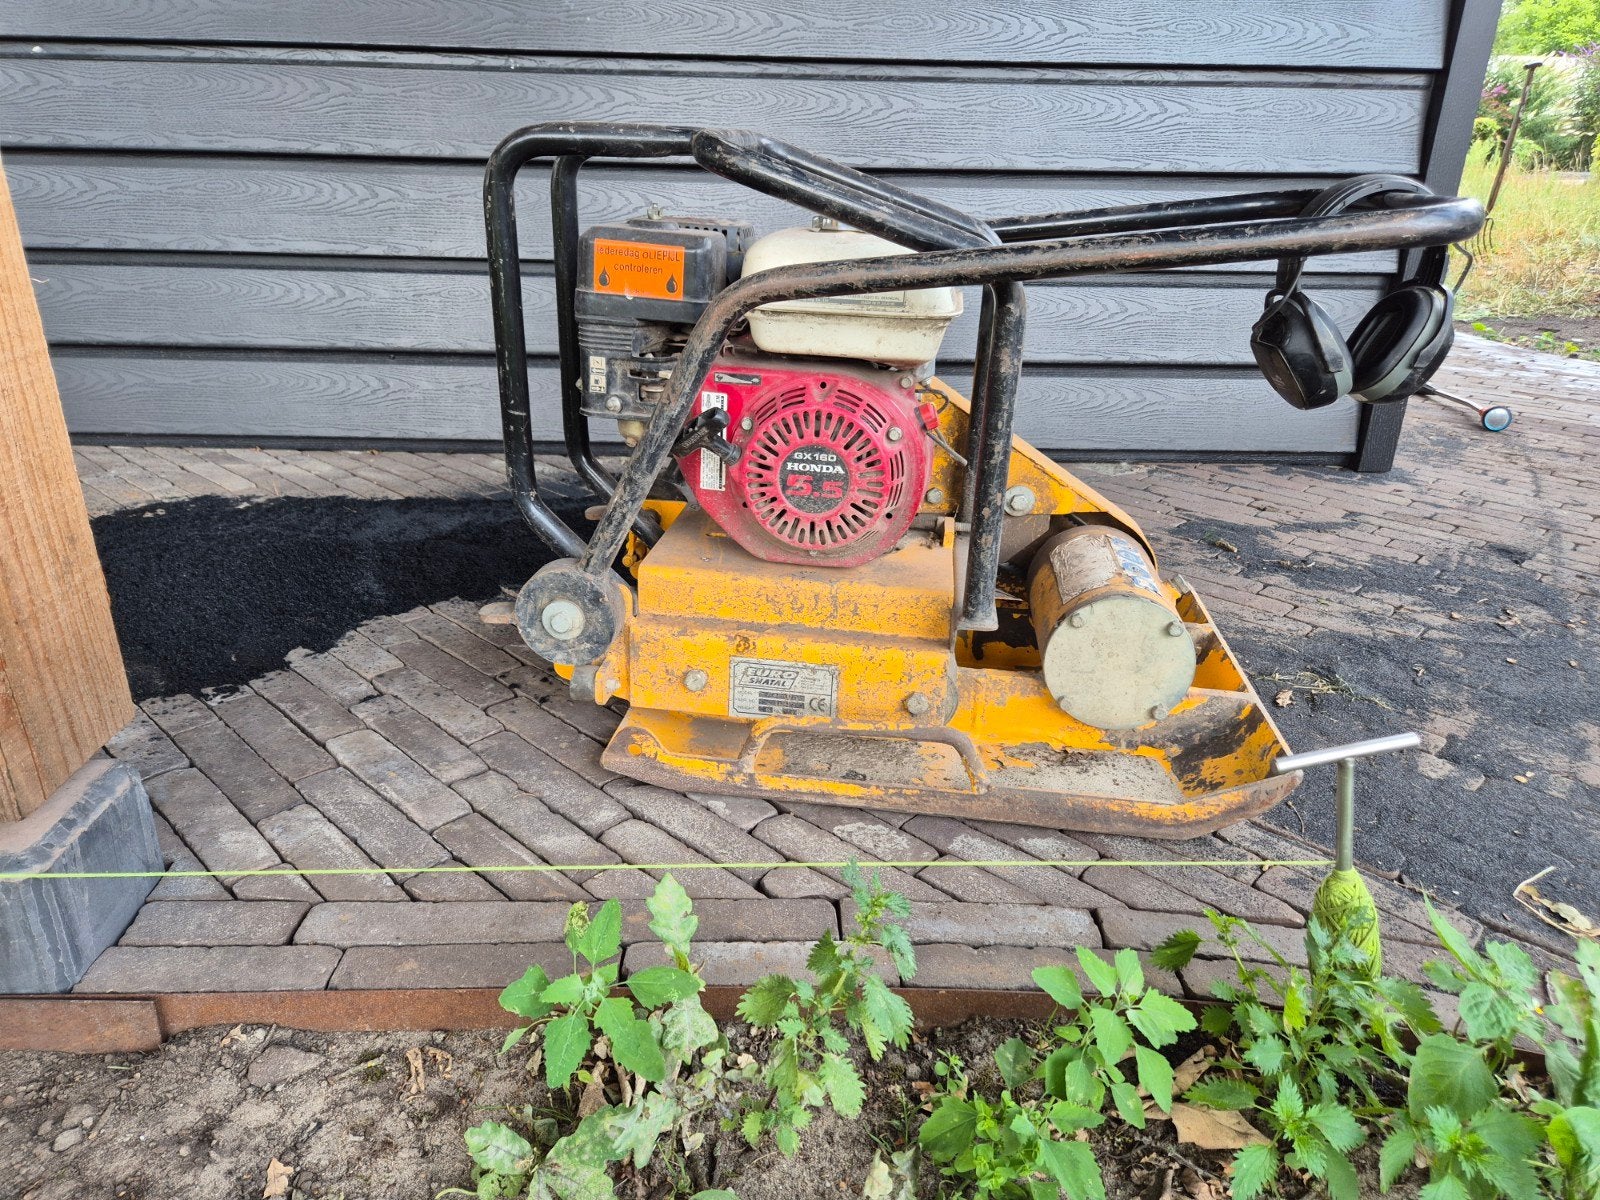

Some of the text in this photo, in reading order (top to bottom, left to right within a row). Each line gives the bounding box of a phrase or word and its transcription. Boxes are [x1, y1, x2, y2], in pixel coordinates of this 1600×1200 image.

[613, 263, 663, 275] controleren
[786, 462, 845, 474] HONDA
[785, 474, 844, 499] 5.5
[747, 667, 799, 679] EURO
[749, 677, 787, 687] SHATAL
[809, 697, 828, 712] CE
